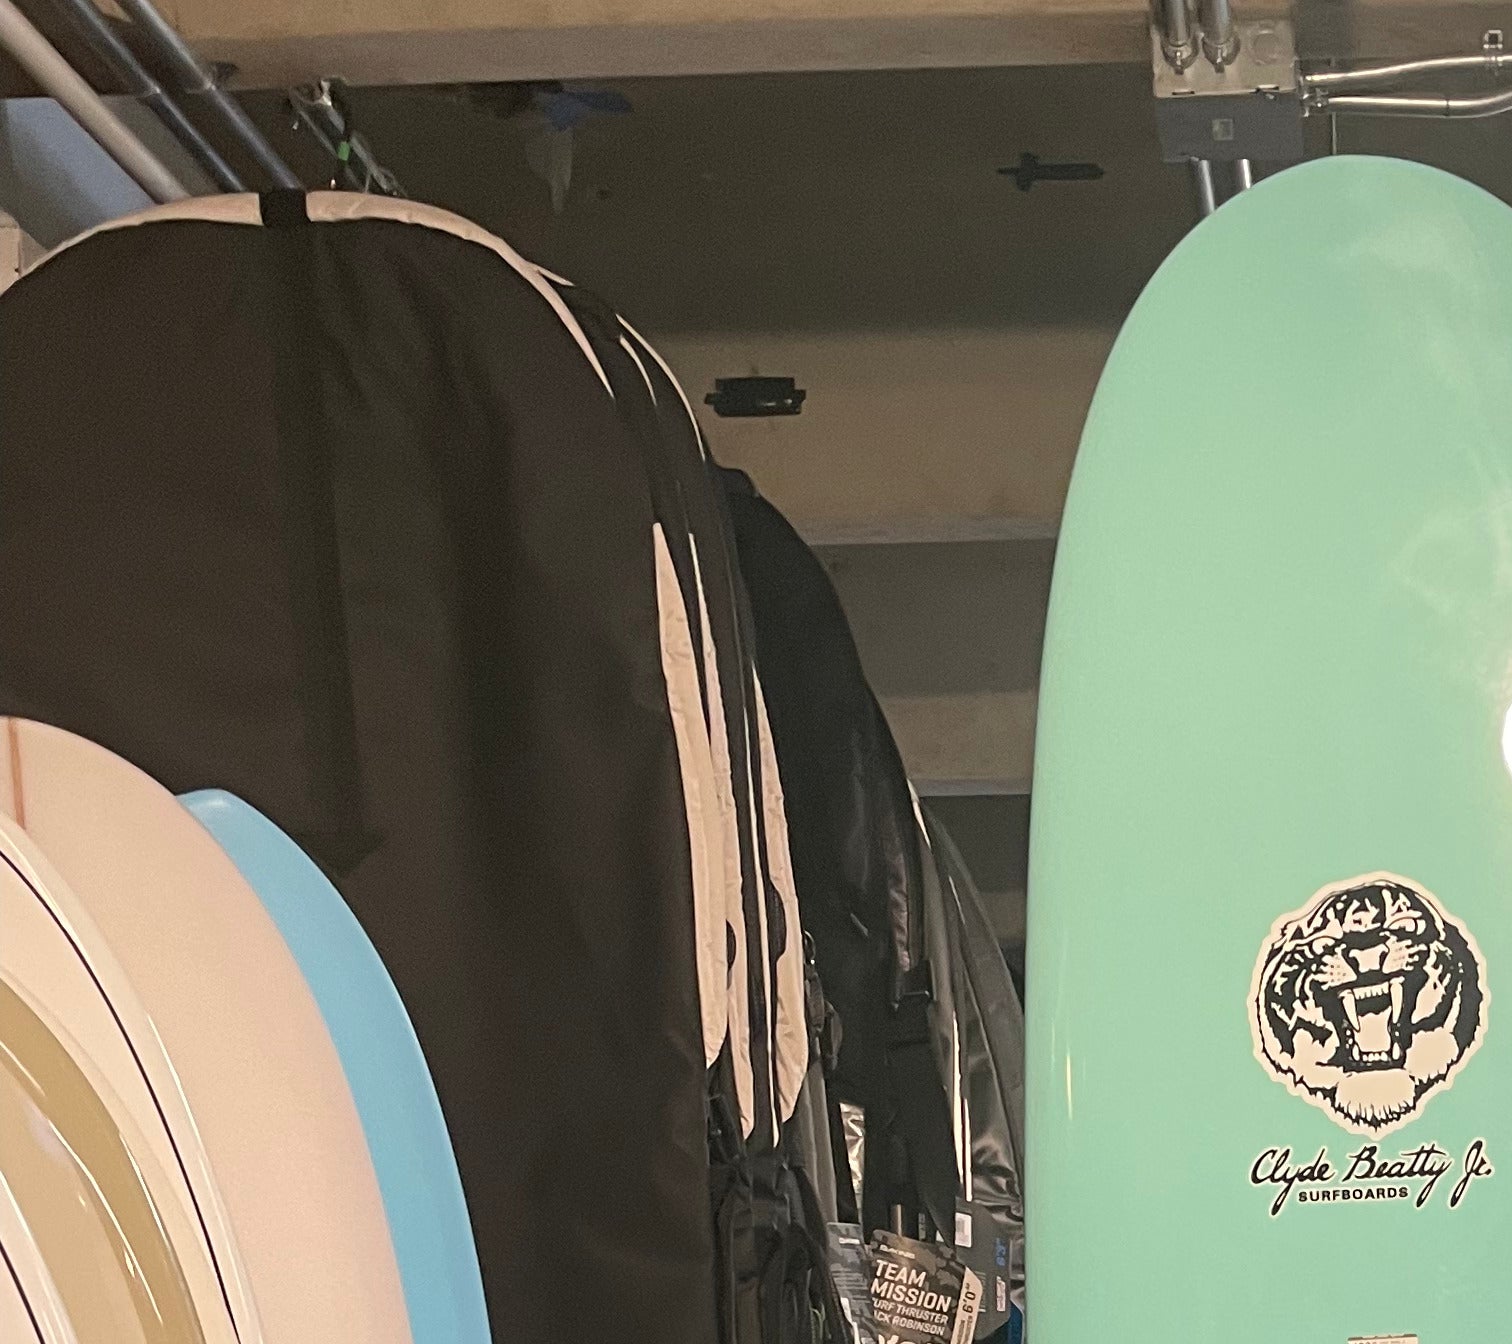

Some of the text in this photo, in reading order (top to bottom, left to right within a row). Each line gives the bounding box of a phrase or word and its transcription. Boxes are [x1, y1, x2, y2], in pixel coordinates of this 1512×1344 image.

[1251, 1140, 1492, 1216] Clyde Beatty Jr.
[1299, 1186, 1409, 1202] SURFBOARDS
[876, 1260, 926, 1287] TEAM
[871, 1278, 951, 1312] MISSION
[896, 1303, 948, 1324] THRUSTER
[892, 1316, 945, 1336] ROBINSON
